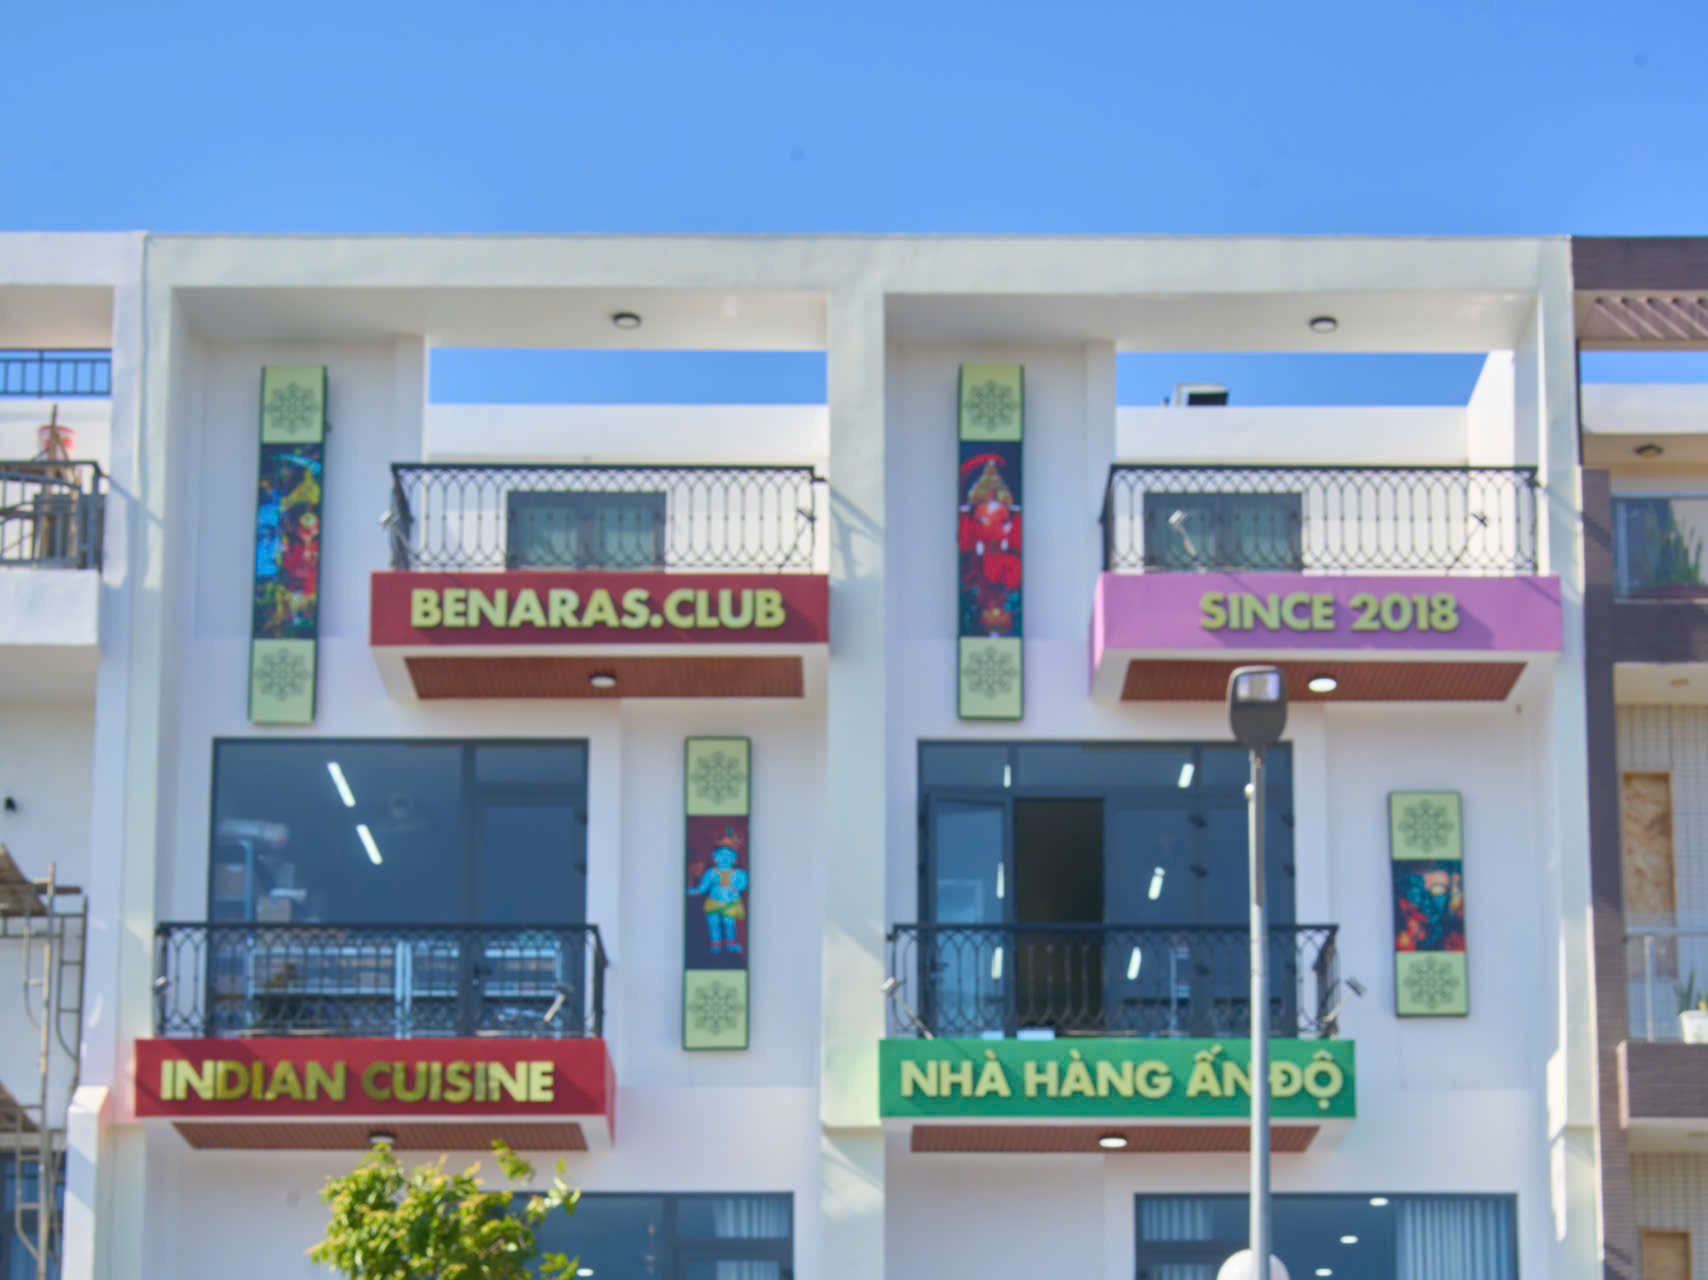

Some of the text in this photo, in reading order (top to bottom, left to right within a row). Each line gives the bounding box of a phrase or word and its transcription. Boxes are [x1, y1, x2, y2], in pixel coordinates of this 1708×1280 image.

[410, 588, 787, 630] BENARAS.CLUB
[1200, 591, 1460, 631] SINCE 2018
[160, 1059, 555, 1102] INDIAN CUISINE
[900, 1044, 1344, 1110] NHÀ HÀNG ẤN ĐỘ
